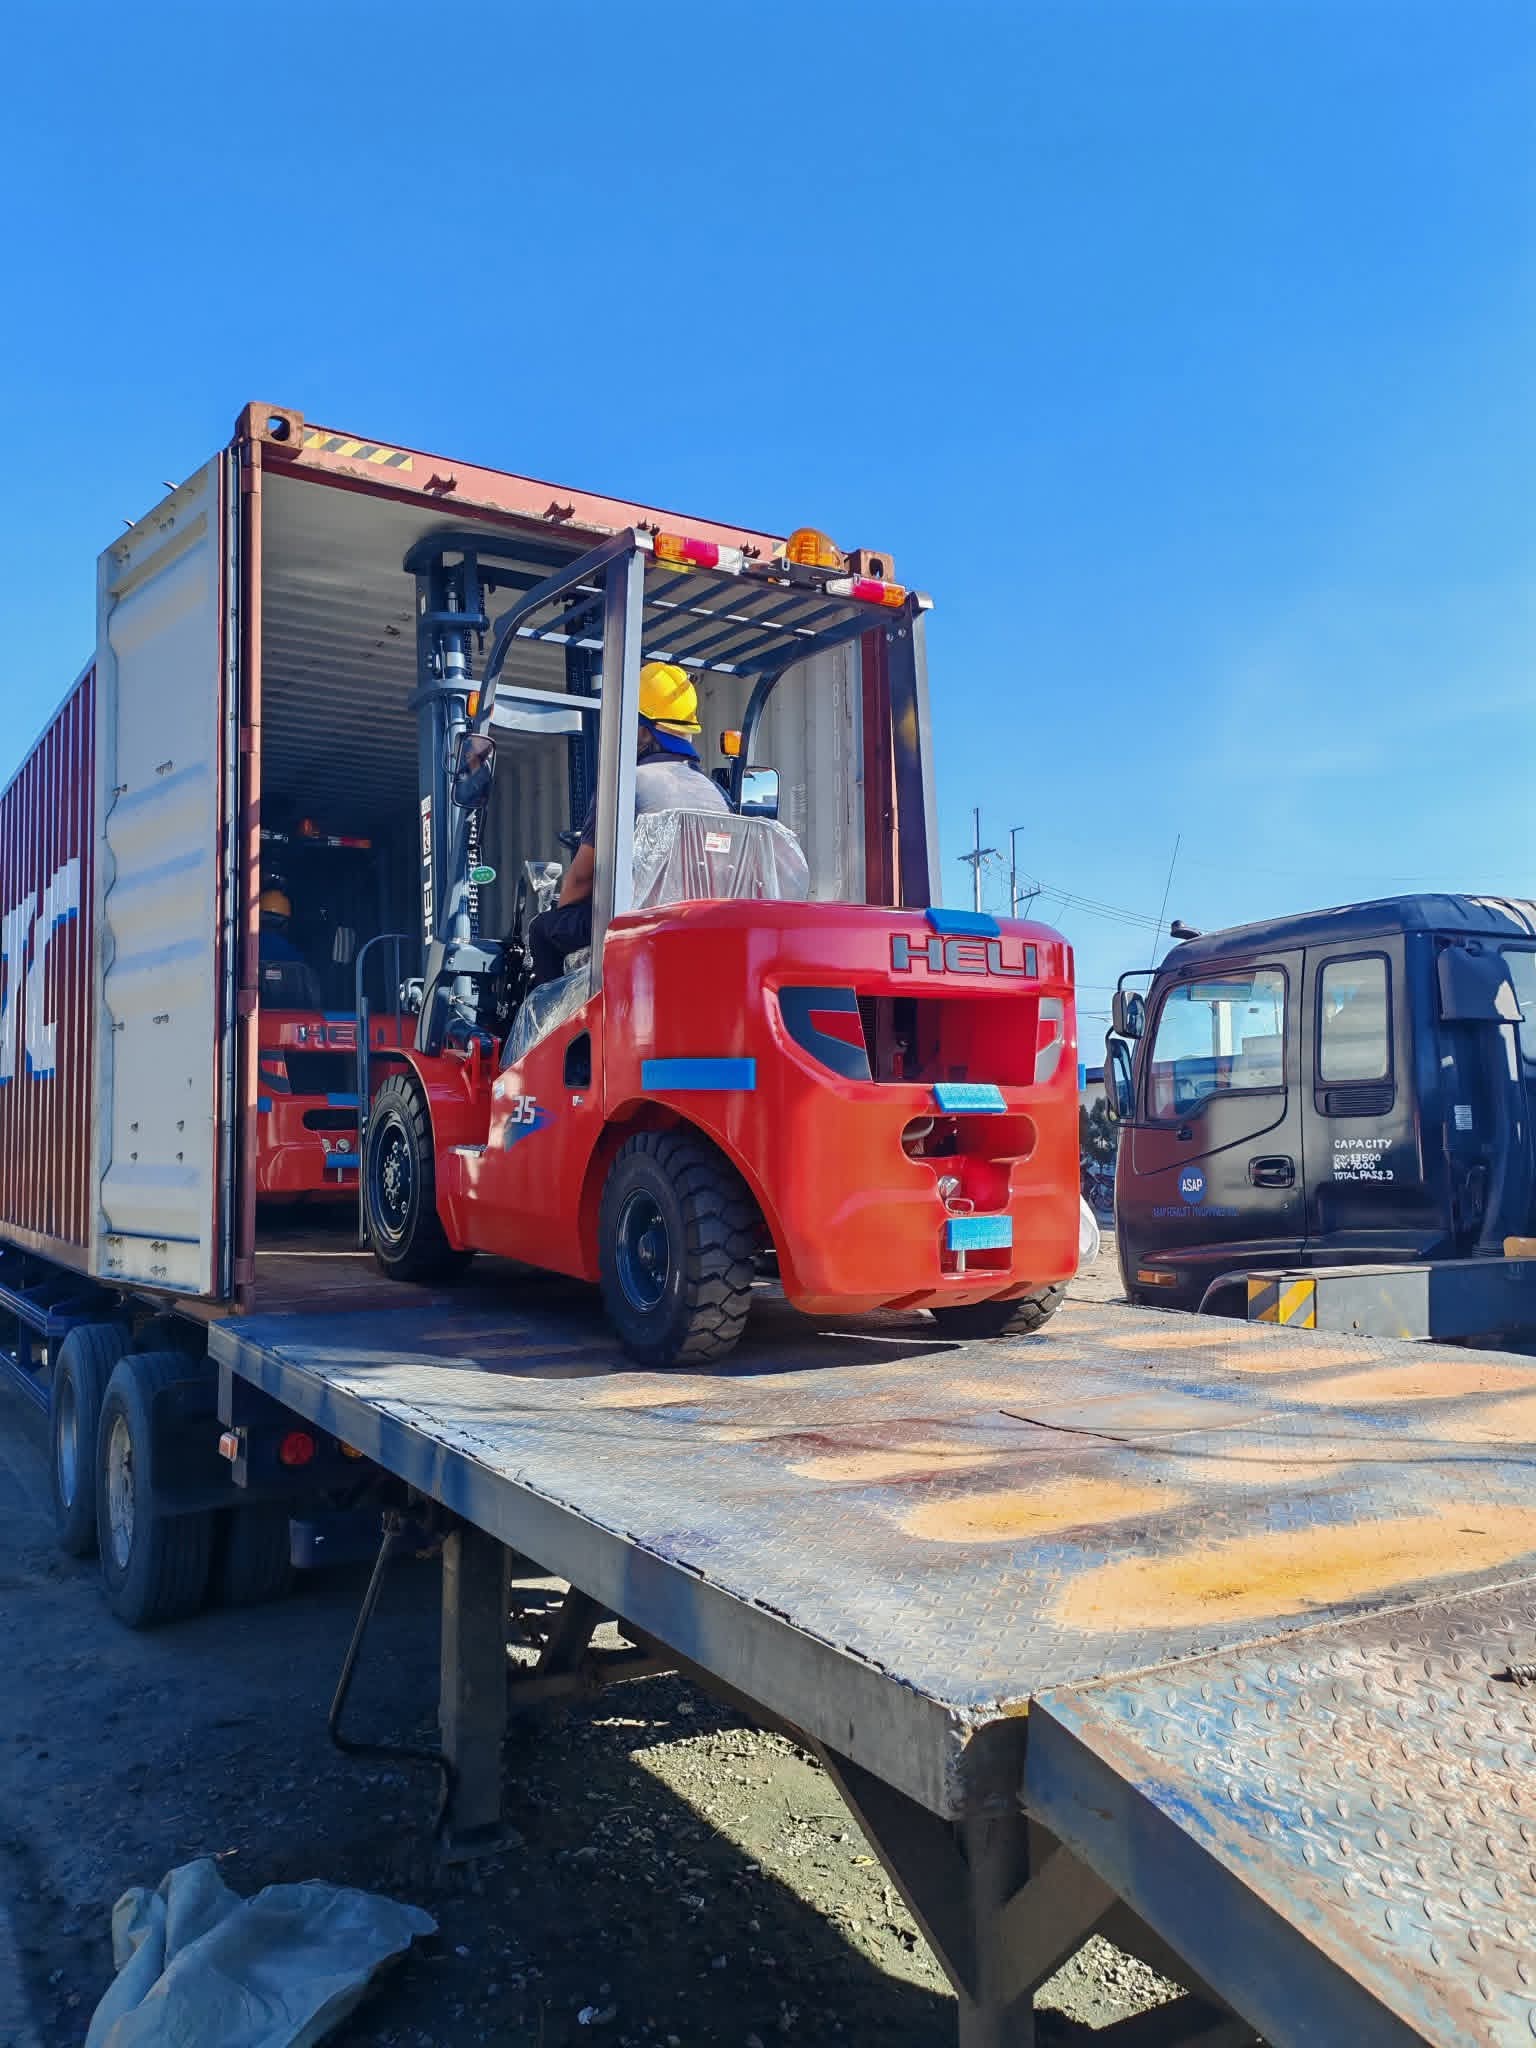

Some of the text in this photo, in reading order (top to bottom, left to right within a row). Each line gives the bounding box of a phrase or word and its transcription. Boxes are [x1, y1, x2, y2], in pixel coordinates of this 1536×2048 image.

[423, 855, 433, 945] HELI
[890, 934, 1038, 979] HELI
[511, 1095, 537, 1125] 35
[1334, 1139, 1392, 1149] CAPACITY
[1182, 1178, 1203, 1192] ASAP
[1333, 1171, 1360, 1180] TOTAL
